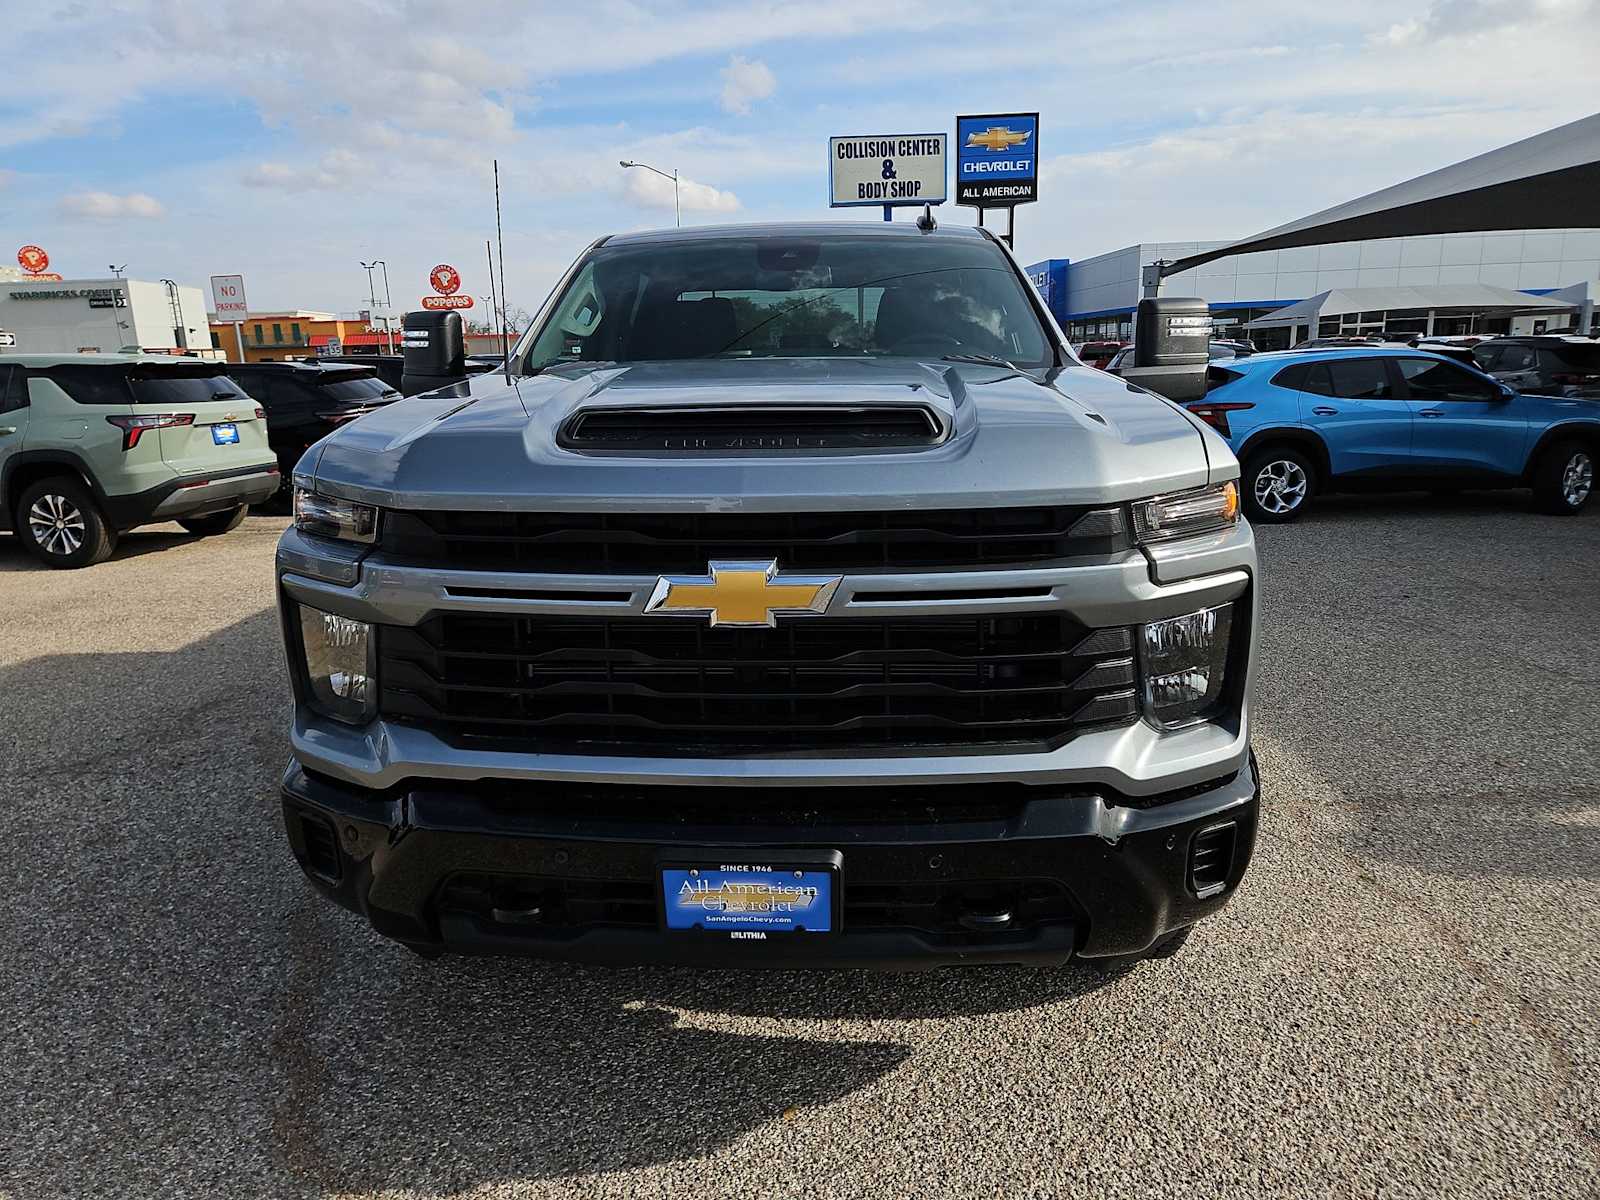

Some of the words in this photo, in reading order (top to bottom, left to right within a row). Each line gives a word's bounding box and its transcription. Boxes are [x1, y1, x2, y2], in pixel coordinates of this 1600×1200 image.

[837, 142, 896, 159] COLLISION
[898, 138, 941, 156] CENTER
[881, 159, 897, 180] &
[963, 160, 1031, 173] CHEVROLET
[857, 181, 888, 199] BODY
[890, 180, 921, 197] SHOP
[962, 187, 980, 198] ALL
[983, 185, 1032, 197] AMERICAN
[10, 291, 77, 300] STARBUCKS
[220, 286, 236, 297] NO
[216, 303, 246, 312] PARKING
[752, 865, 772, 873] 1946
[678, 879, 709, 895] All
[720, 880, 819, 896] American
[701, 894, 794, 912] Chevrolet
[706, 915, 792, 923] SanAngeloChevy.com
[738, 931, 767, 940] LITHIA
